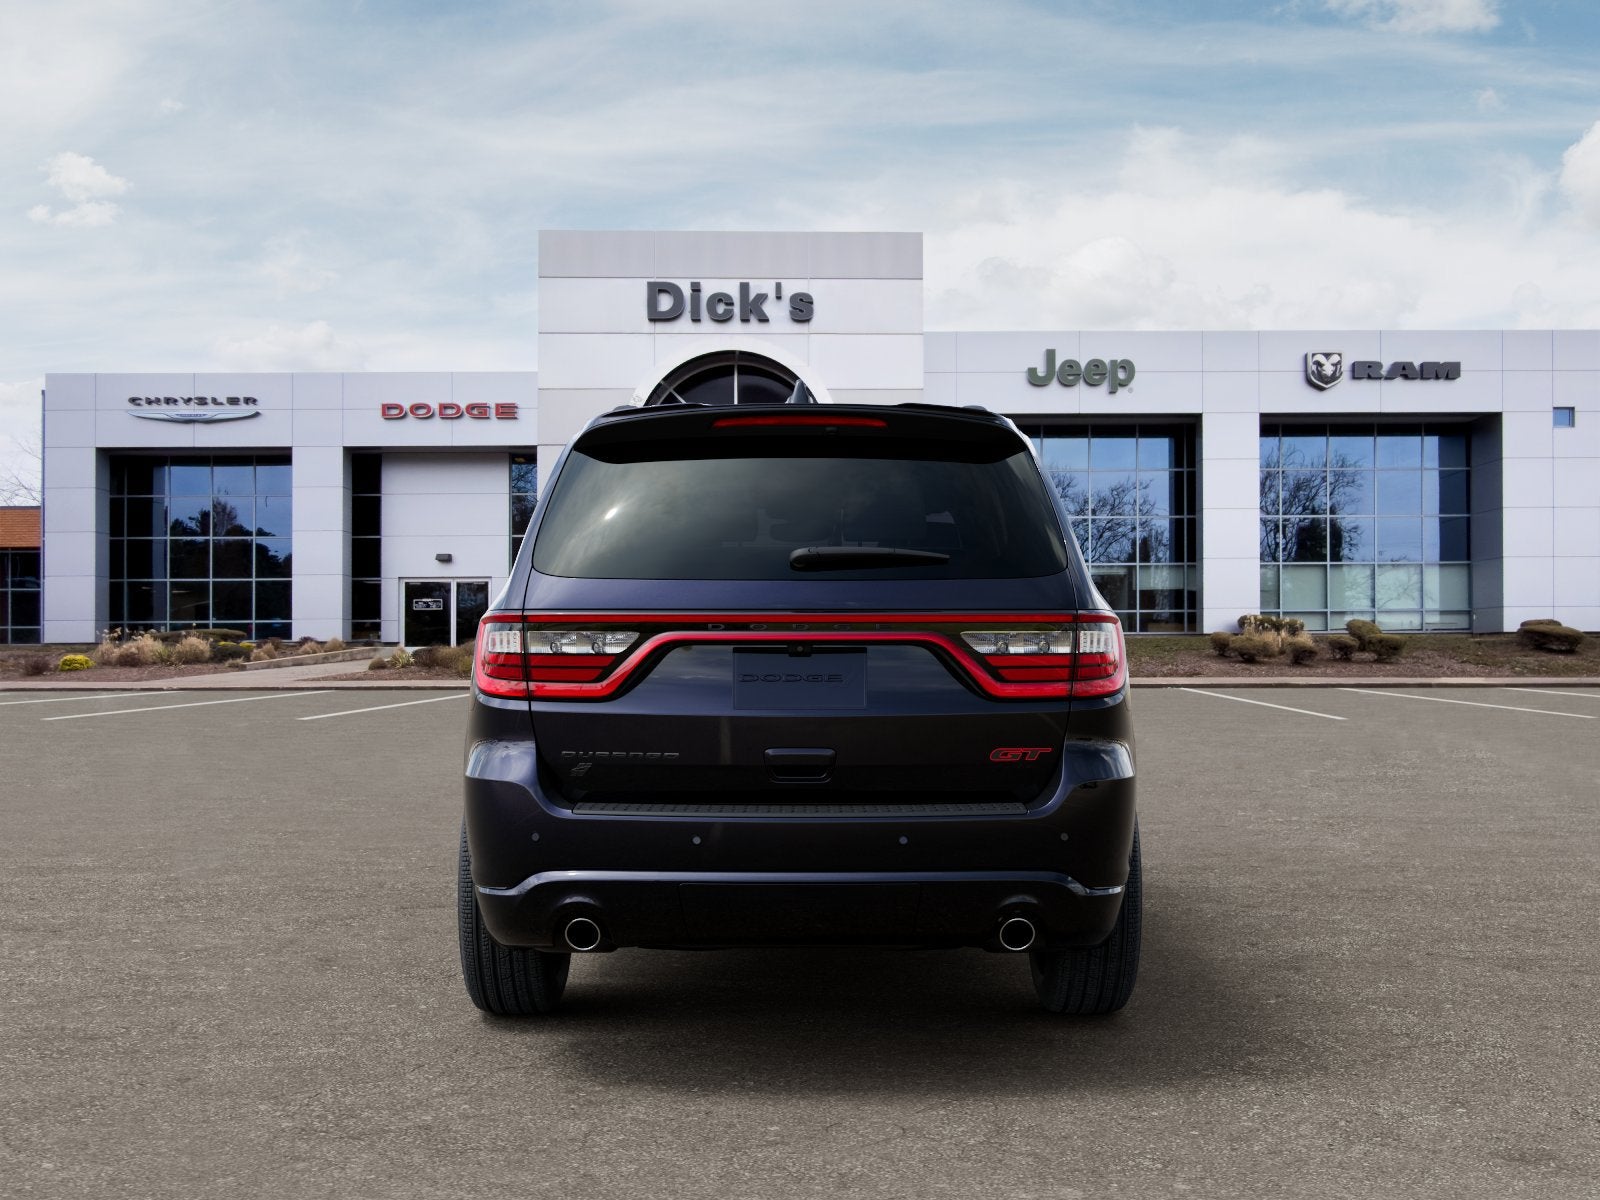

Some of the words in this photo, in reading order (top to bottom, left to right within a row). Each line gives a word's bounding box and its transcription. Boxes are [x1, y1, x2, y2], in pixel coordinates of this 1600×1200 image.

[647, 281, 814, 322] Dick's
[1027, 348, 1136, 394] Jeep
[1352, 360, 1461, 380] RAM
[128, 396, 259, 407] CHRYSLER
[381, 402, 518, 420] DODGE
[707, 623, 892, 631] DODGE
[738, 673, 843, 683] DODGE
[989, 747, 1052, 761] GT
